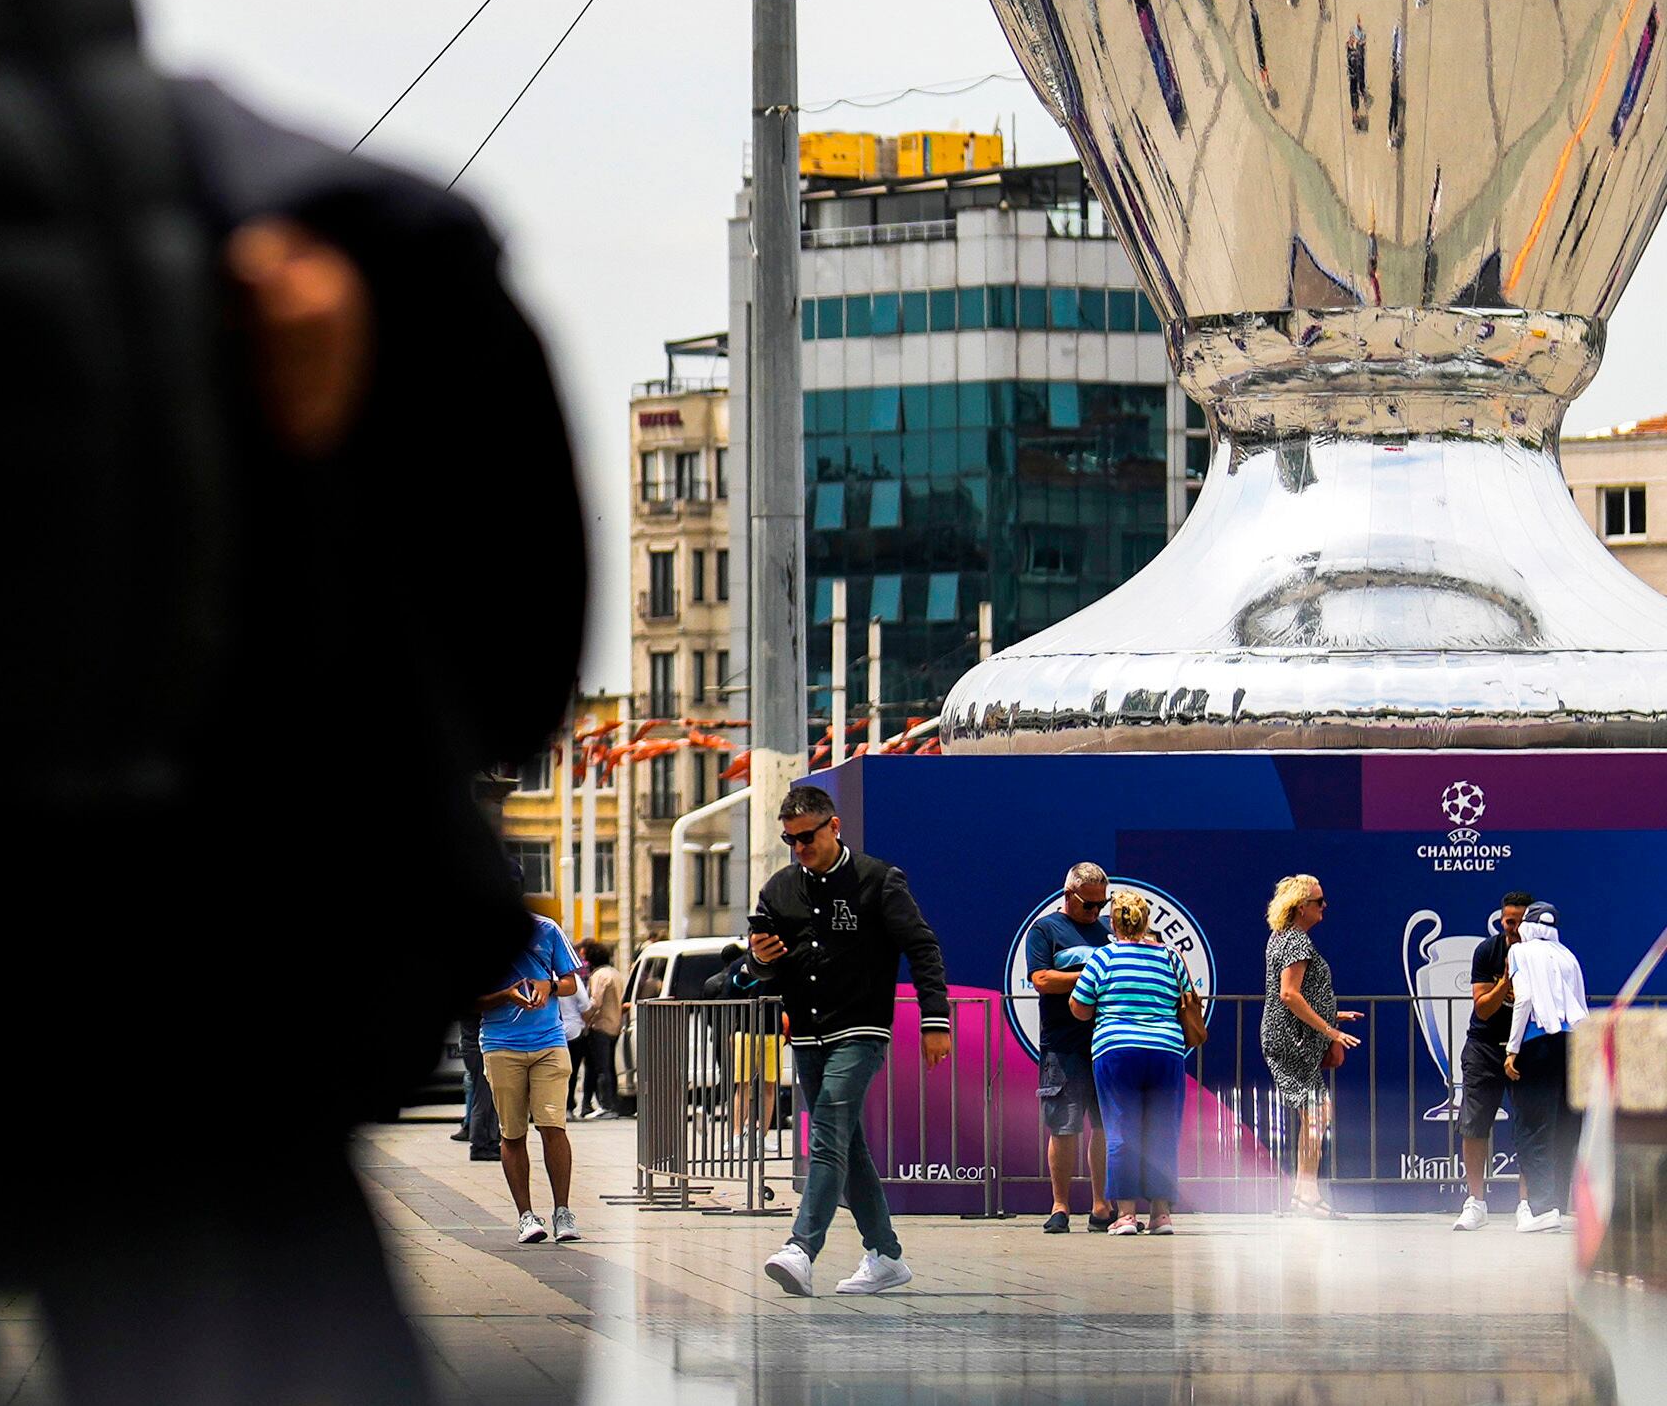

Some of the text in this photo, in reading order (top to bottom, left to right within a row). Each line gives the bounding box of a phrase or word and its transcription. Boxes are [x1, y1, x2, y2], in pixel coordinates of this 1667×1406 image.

[1449, 830, 1478, 843] UEFA
[1416, 845, 1512, 858] CHAMPIONS
[1434, 859, 1496, 871] LEAGUE
[1439, 1184, 1492, 1193] FINL
